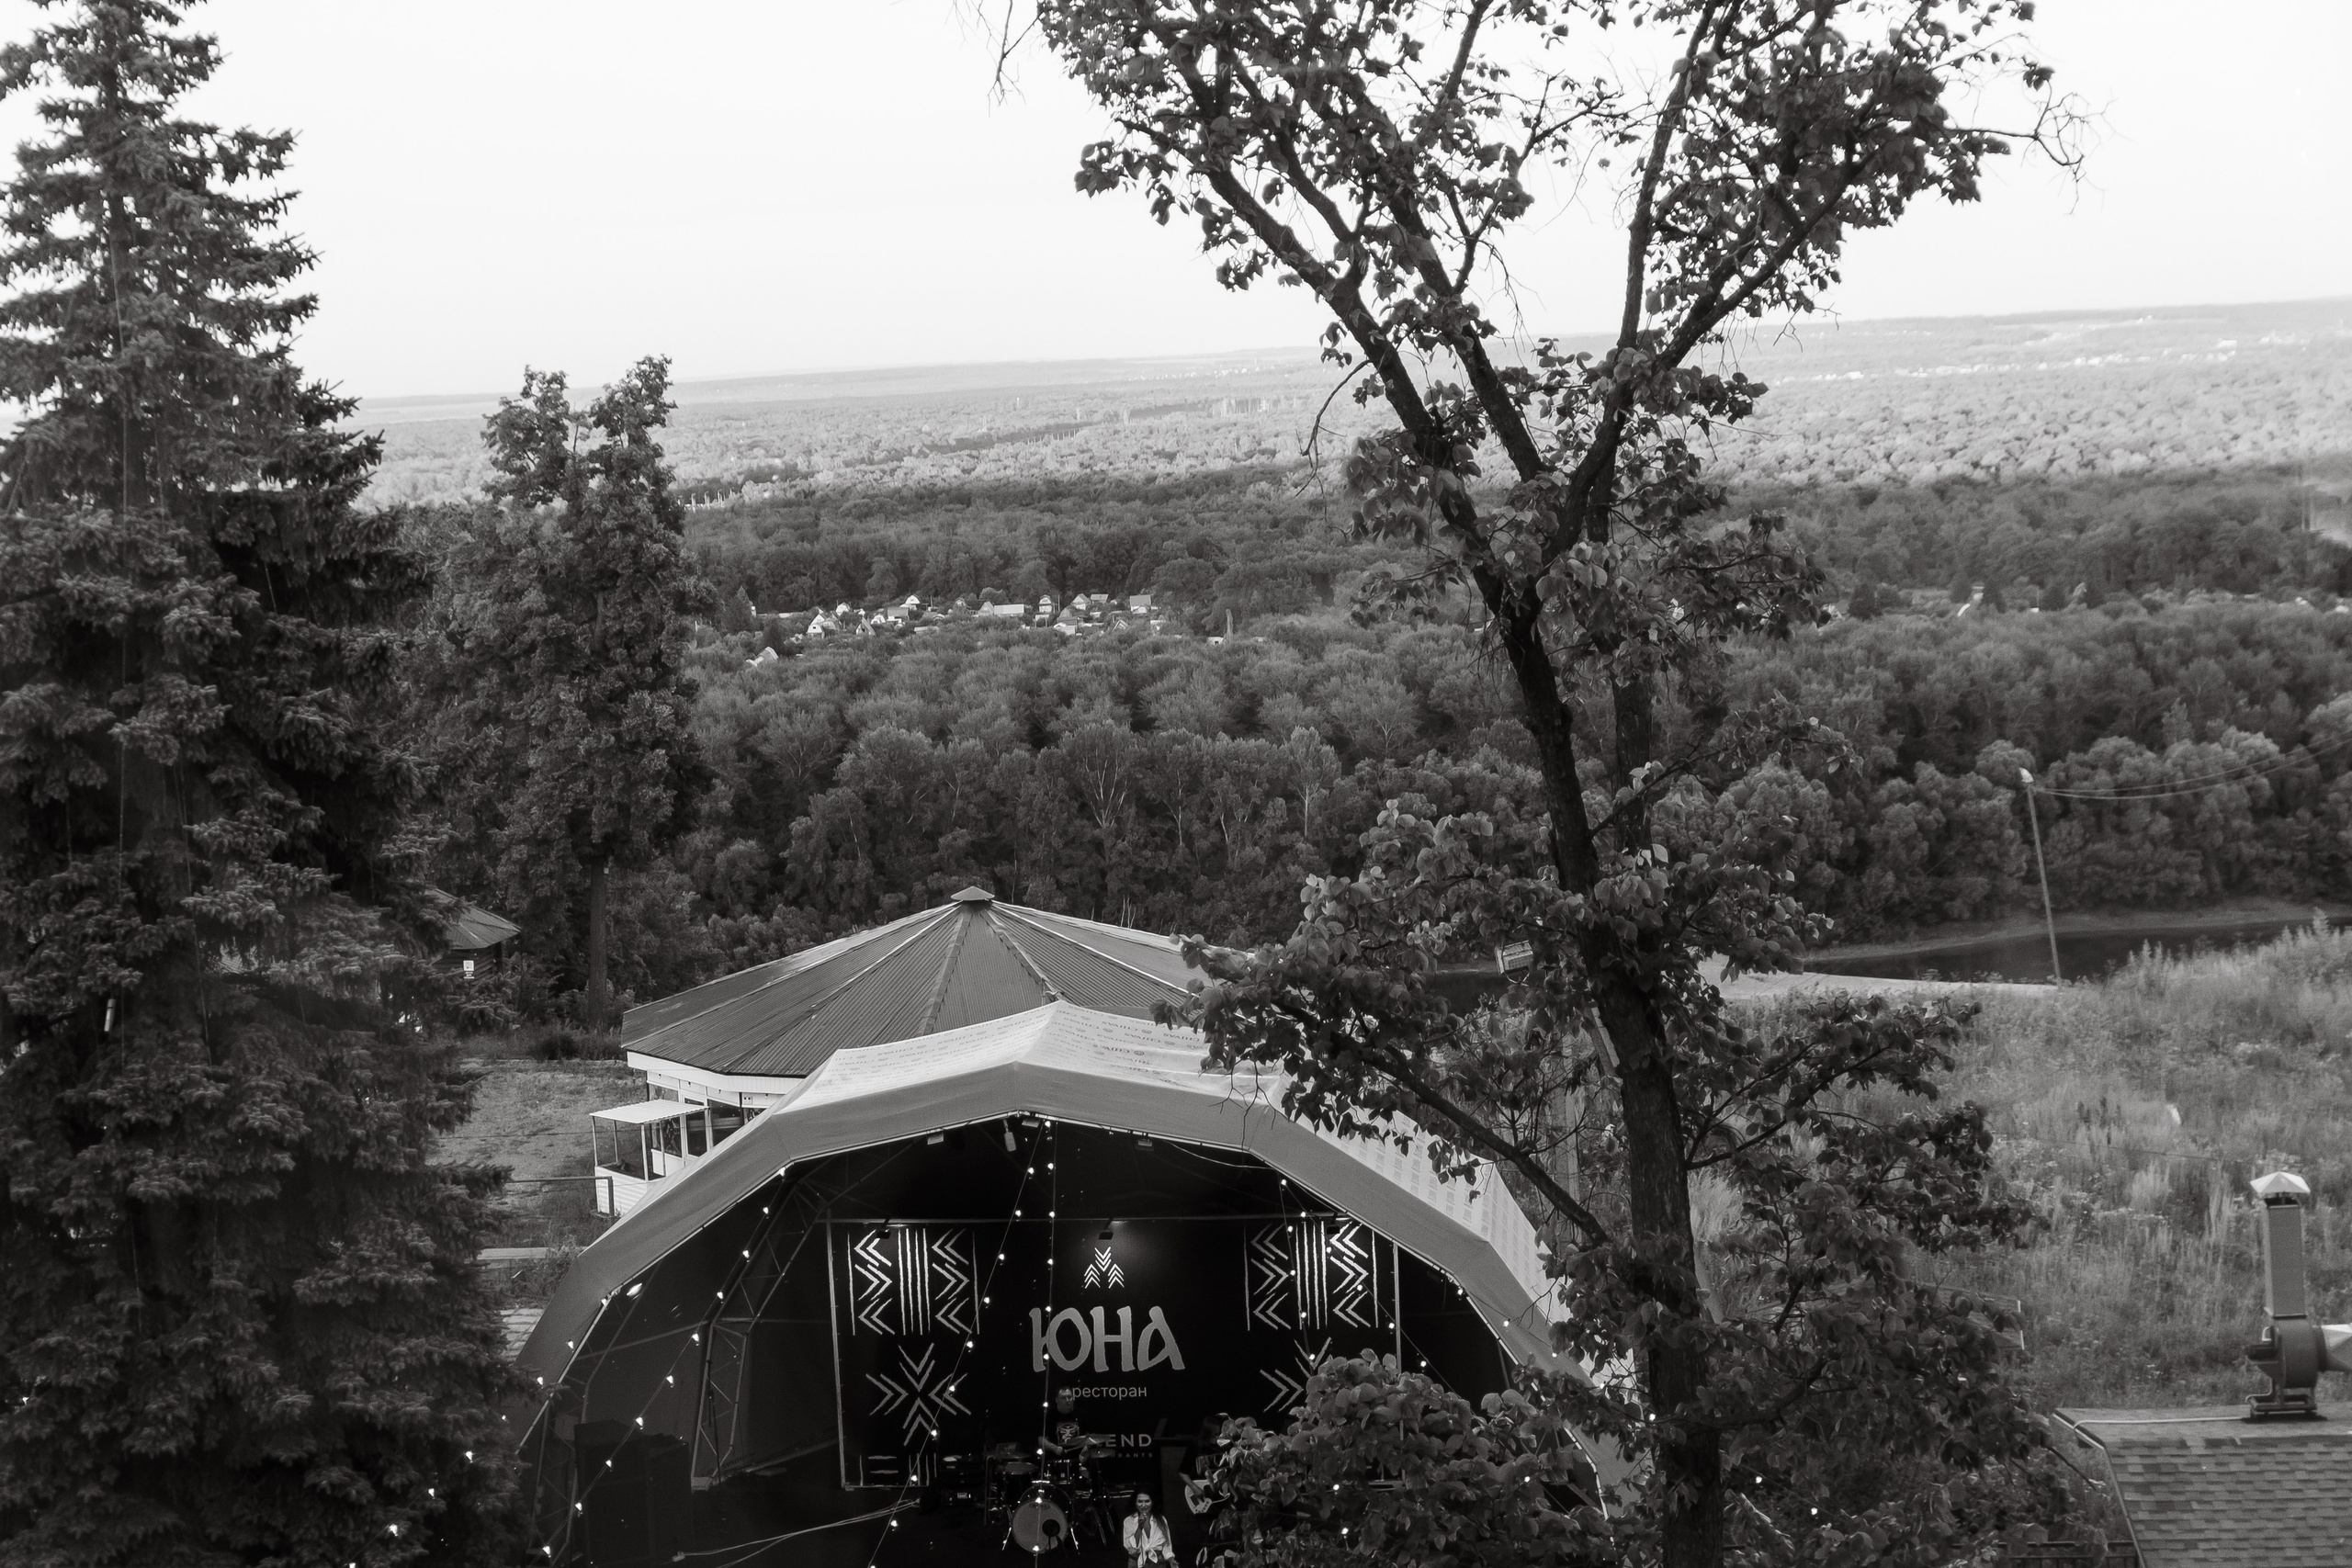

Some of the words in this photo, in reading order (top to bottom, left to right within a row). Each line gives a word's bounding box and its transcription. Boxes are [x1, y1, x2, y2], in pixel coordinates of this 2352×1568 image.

[1029, 1305, 1185, 1372] ЮНА
[1072, 1386, 1148, 1401] ресторан
[1105, 1433, 1152, 1448] END
